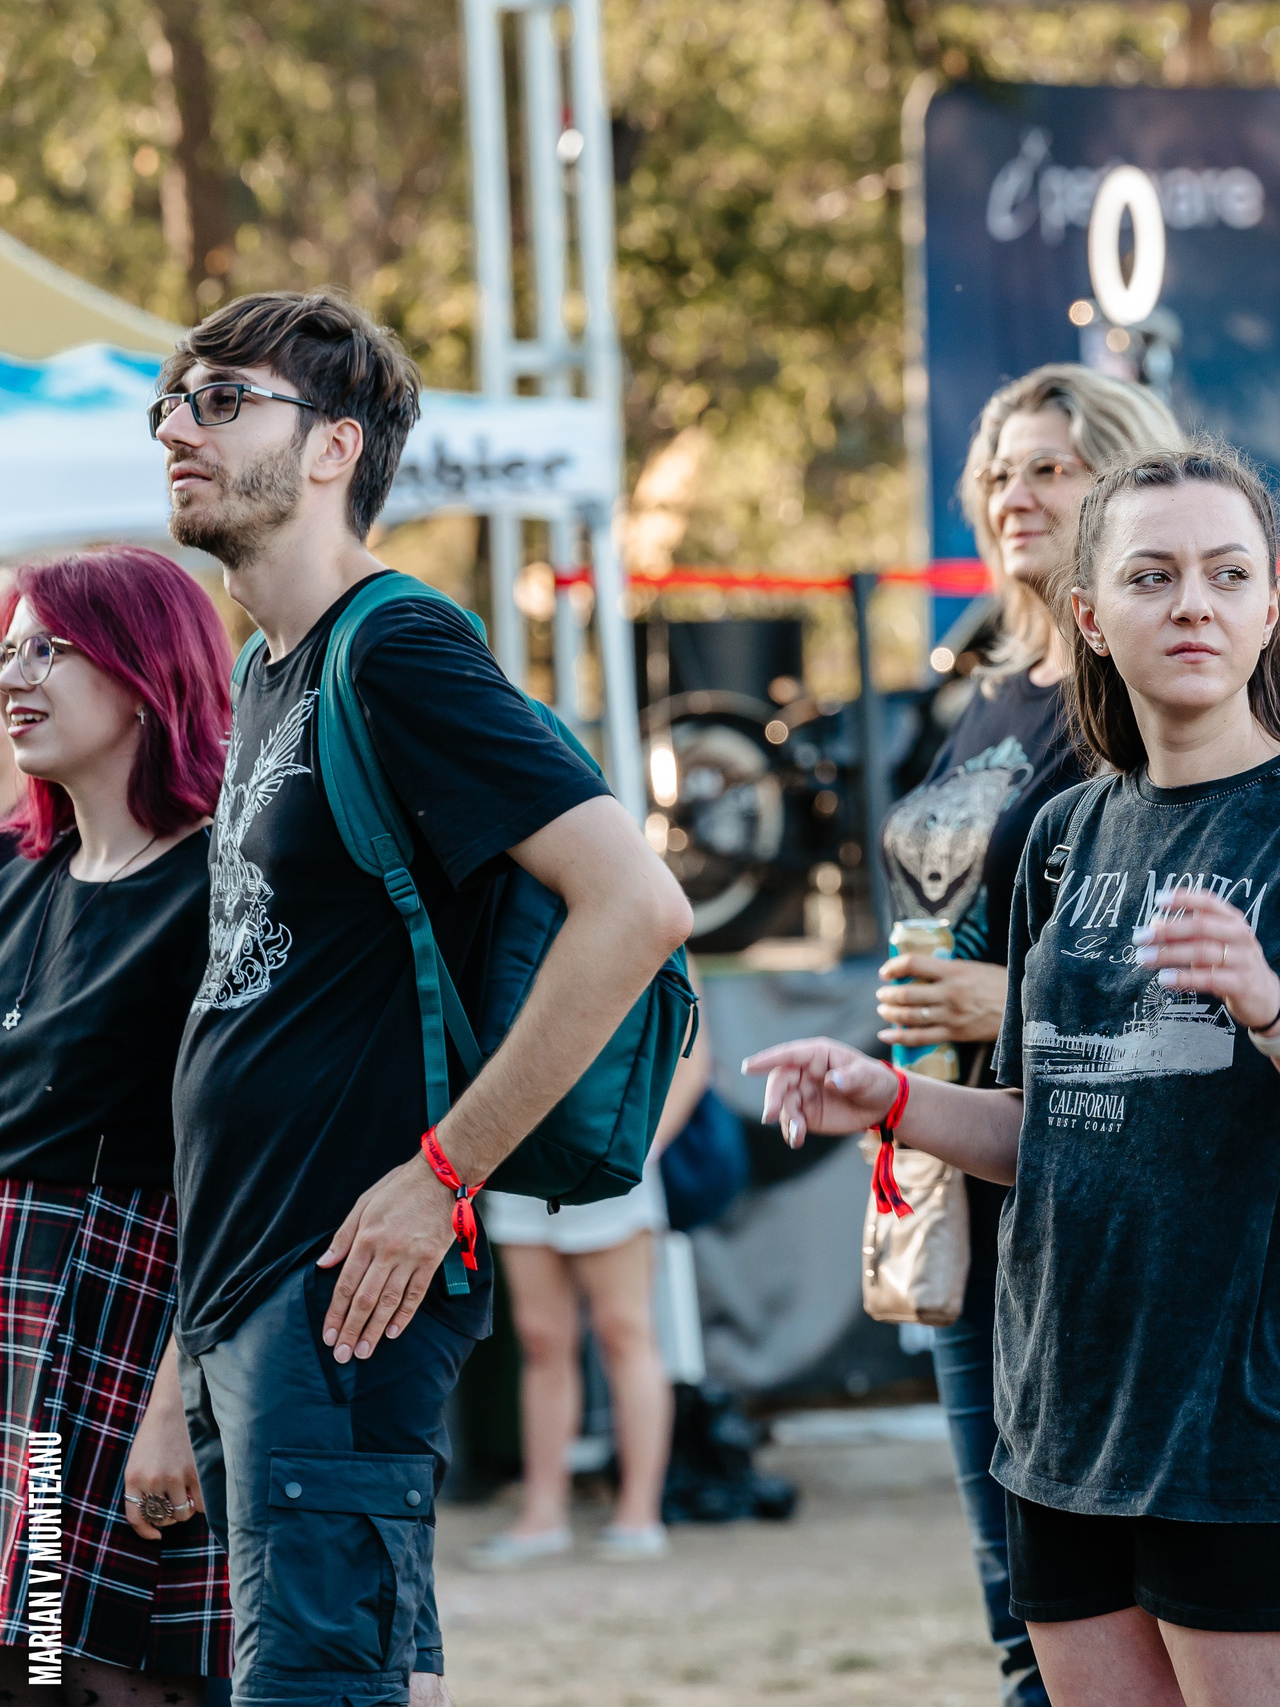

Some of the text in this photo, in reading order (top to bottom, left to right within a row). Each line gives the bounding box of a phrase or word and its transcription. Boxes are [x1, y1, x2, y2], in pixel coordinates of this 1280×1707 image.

[1060, 935, 1107, 959] Los
[1048, 1089, 1124, 1120] CALIFORNIA
[1048, 1116, 1122, 1133] WEST COAST
